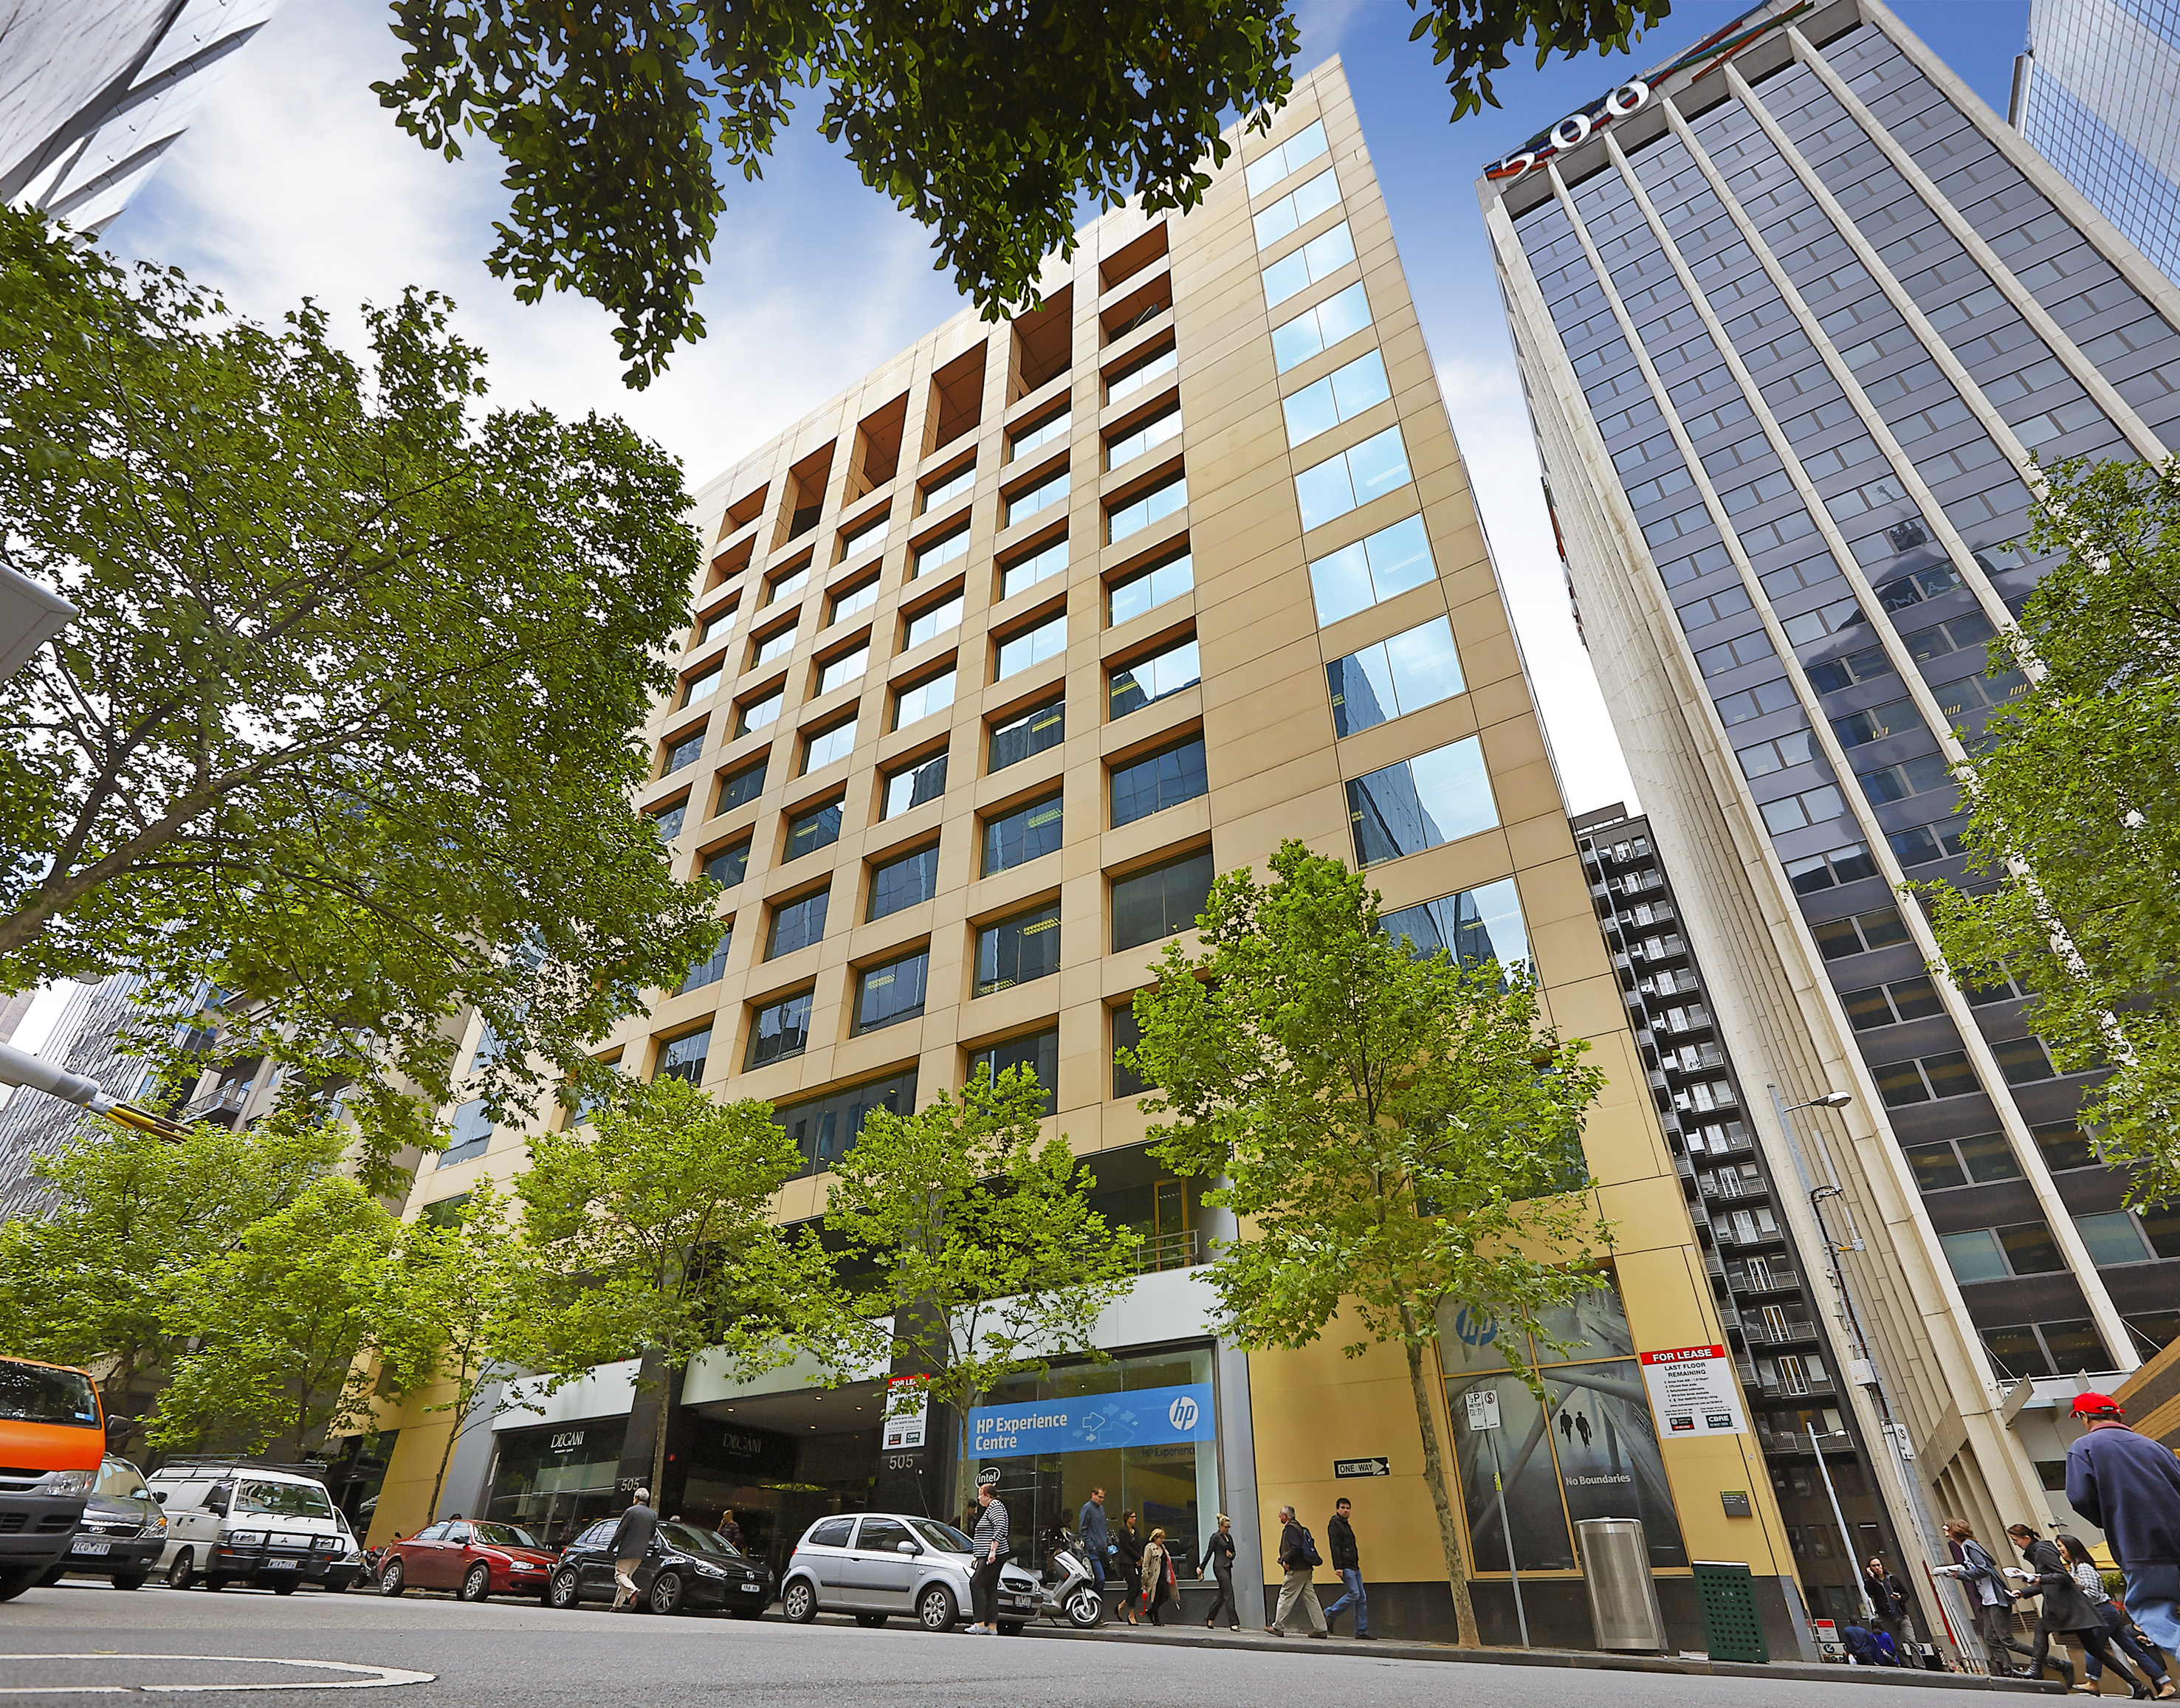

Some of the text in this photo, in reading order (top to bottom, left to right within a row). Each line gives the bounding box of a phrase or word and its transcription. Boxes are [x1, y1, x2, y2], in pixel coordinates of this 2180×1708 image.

[1500, 80, 1649, 185] 500
[1652, 1348, 1713, 1362] FOR LEASE
[1683, 1362, 1706, 1370] FLOOR
[1668, 1369, 1706, 1378] REMAINING
[1172, 1397, 1195, 1430] hp
[976, 1413, 1067, 1434] HP Experience
[550, 1431, 585, 1448] DEGANI
[975, 1435, 1017, 1451] Centre
[889, 1454, 913, 1470] 505
[1340, 1463, 1372, 1473] ONE WAY
[978, 1471, 997, 1484] intel
[1565, 1473, 1631, 1486] No Boundaries
[620, 1478, 640, 1492] 505
